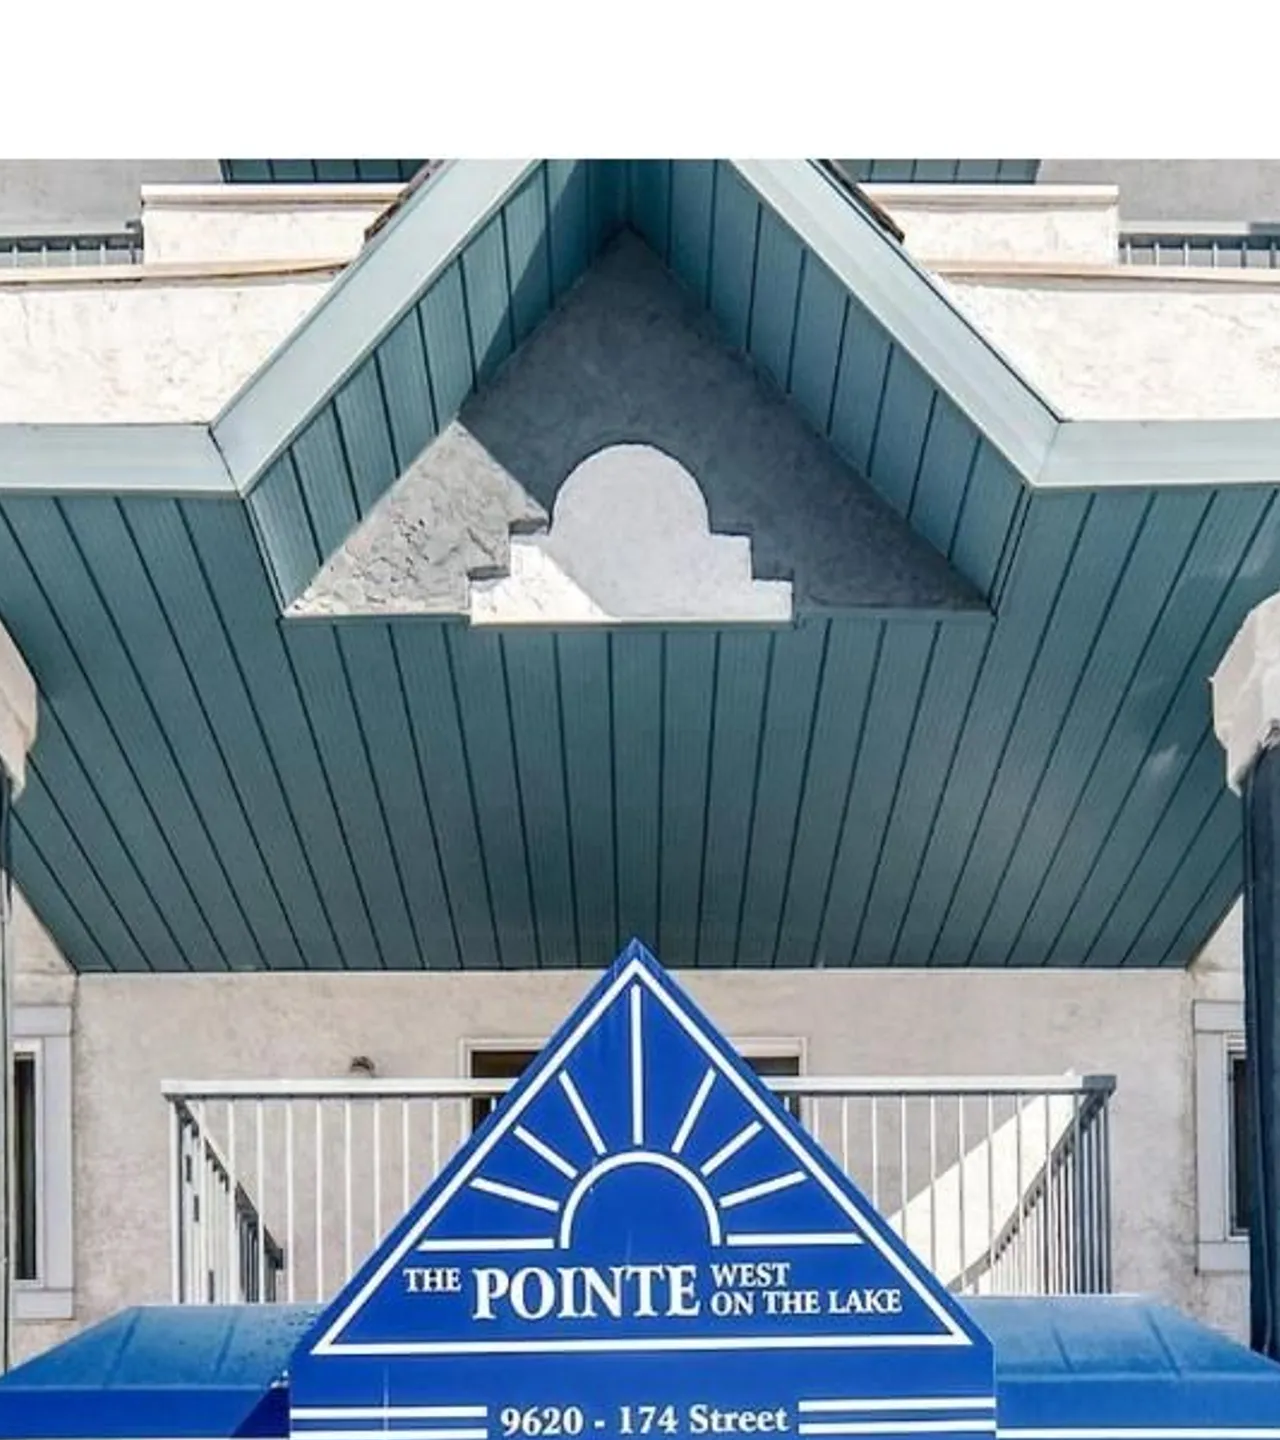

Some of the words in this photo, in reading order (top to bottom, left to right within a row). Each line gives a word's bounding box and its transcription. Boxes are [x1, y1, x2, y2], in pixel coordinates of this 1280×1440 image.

[710, 1262, 791, 1288] WEST
[403, 1267, 462, 1293] THE
[472, 1264, 702, 1320] POINTE
[710, 1290, 755, 1317] ON
[763, 1290, 821, 1315] THE
[827, 1288, 904, 1314] LAKE
[500, 1405, 585, 1437] 9620
[619, 1405, 679, 1434] 174
[689, 1404, 790, 1433] Street
